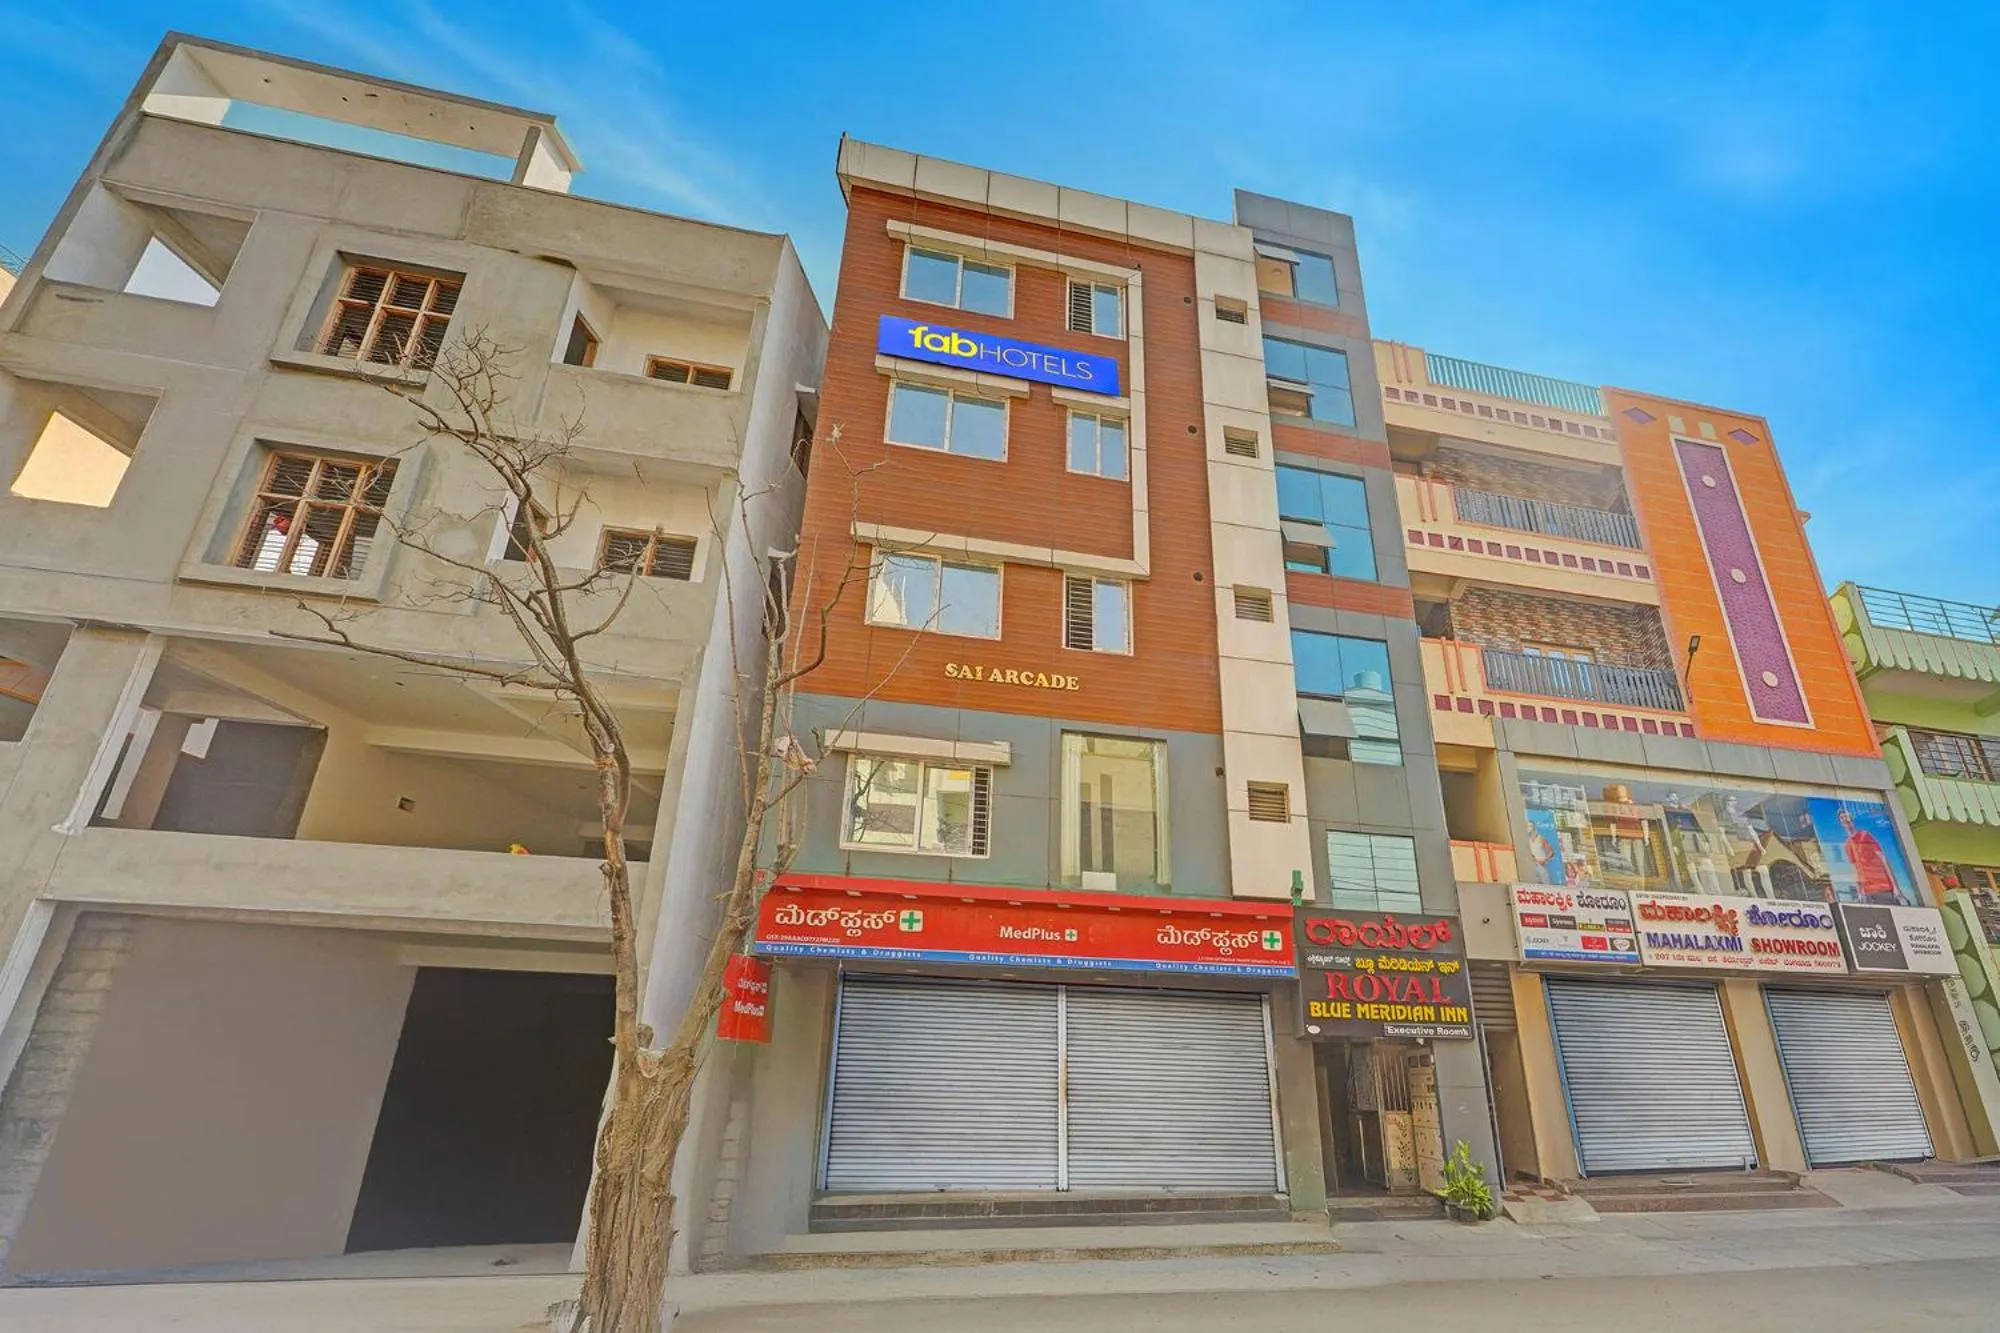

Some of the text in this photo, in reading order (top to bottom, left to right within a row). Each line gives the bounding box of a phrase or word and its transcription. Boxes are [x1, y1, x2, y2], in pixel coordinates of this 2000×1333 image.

[945, 663, 1080, 691] SAI ARCADE
[1000, 926, 1061, 942] MedPlus
[766, 944, 803, 953] Quality
[810, 945, 855, 956] Chemists
[873, 949, 921, 959] Druggists
[1646, 932, 1744, 952] MAHALAXMI
[1751, 937, 1840, 957] SHOWROOM
[1858, 941, 1896, 952] JOCKEY
[968, 953, 1004, 963] Quality
[1010, 955, 1051, 965] Chemists
[1067, 958, 1112, 967] Druggists
[1155, 962, 1188, 972] Quality
[1193, 964, 1232, 973] Chemists
[1246, 967, 1288, 975] Druggists
[1323, 971, 1453, 1004] ROYAL
[1308, 1001, 1468, 1024] BLUE MERIDIAN INN
[1385, 1026, 1434, 1035] Executive
